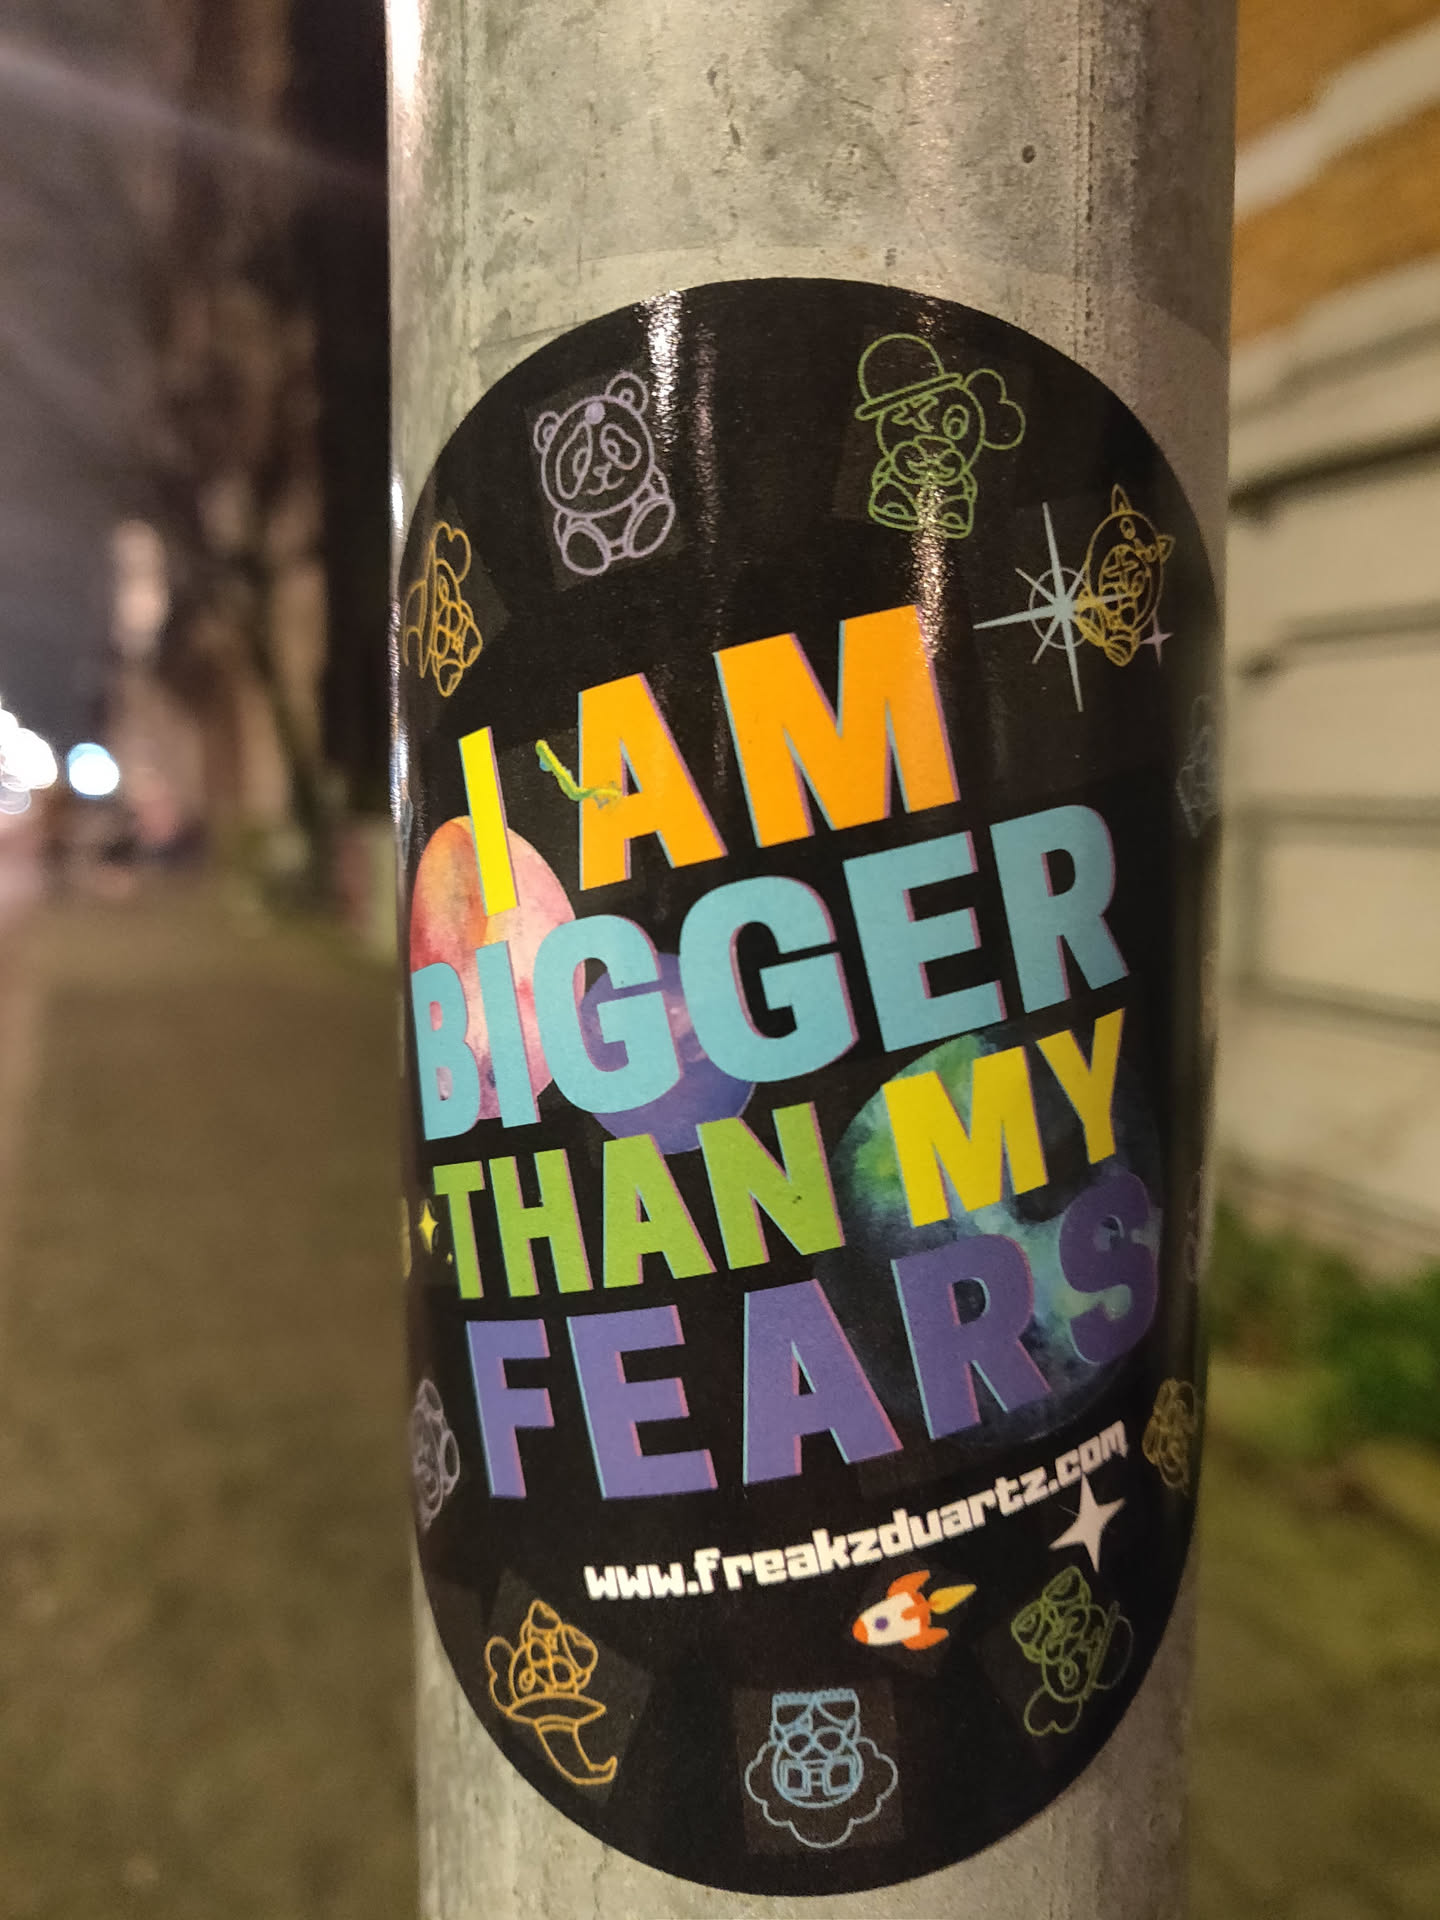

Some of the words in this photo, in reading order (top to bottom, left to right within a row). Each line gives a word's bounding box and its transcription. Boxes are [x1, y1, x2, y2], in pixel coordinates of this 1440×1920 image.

[459, 726, 518, 916] I
[579, 605, 960, 891] AM
[411, 804, 1129, 1140] BIGGER
[432, 1102, 845, 1299] THAN
[882, 1008, 1125, 1227] MY
[466, 1172, 1160, 1500] FEARS
[585, 1420, 1128, 1600] www.freakzduartz.com
